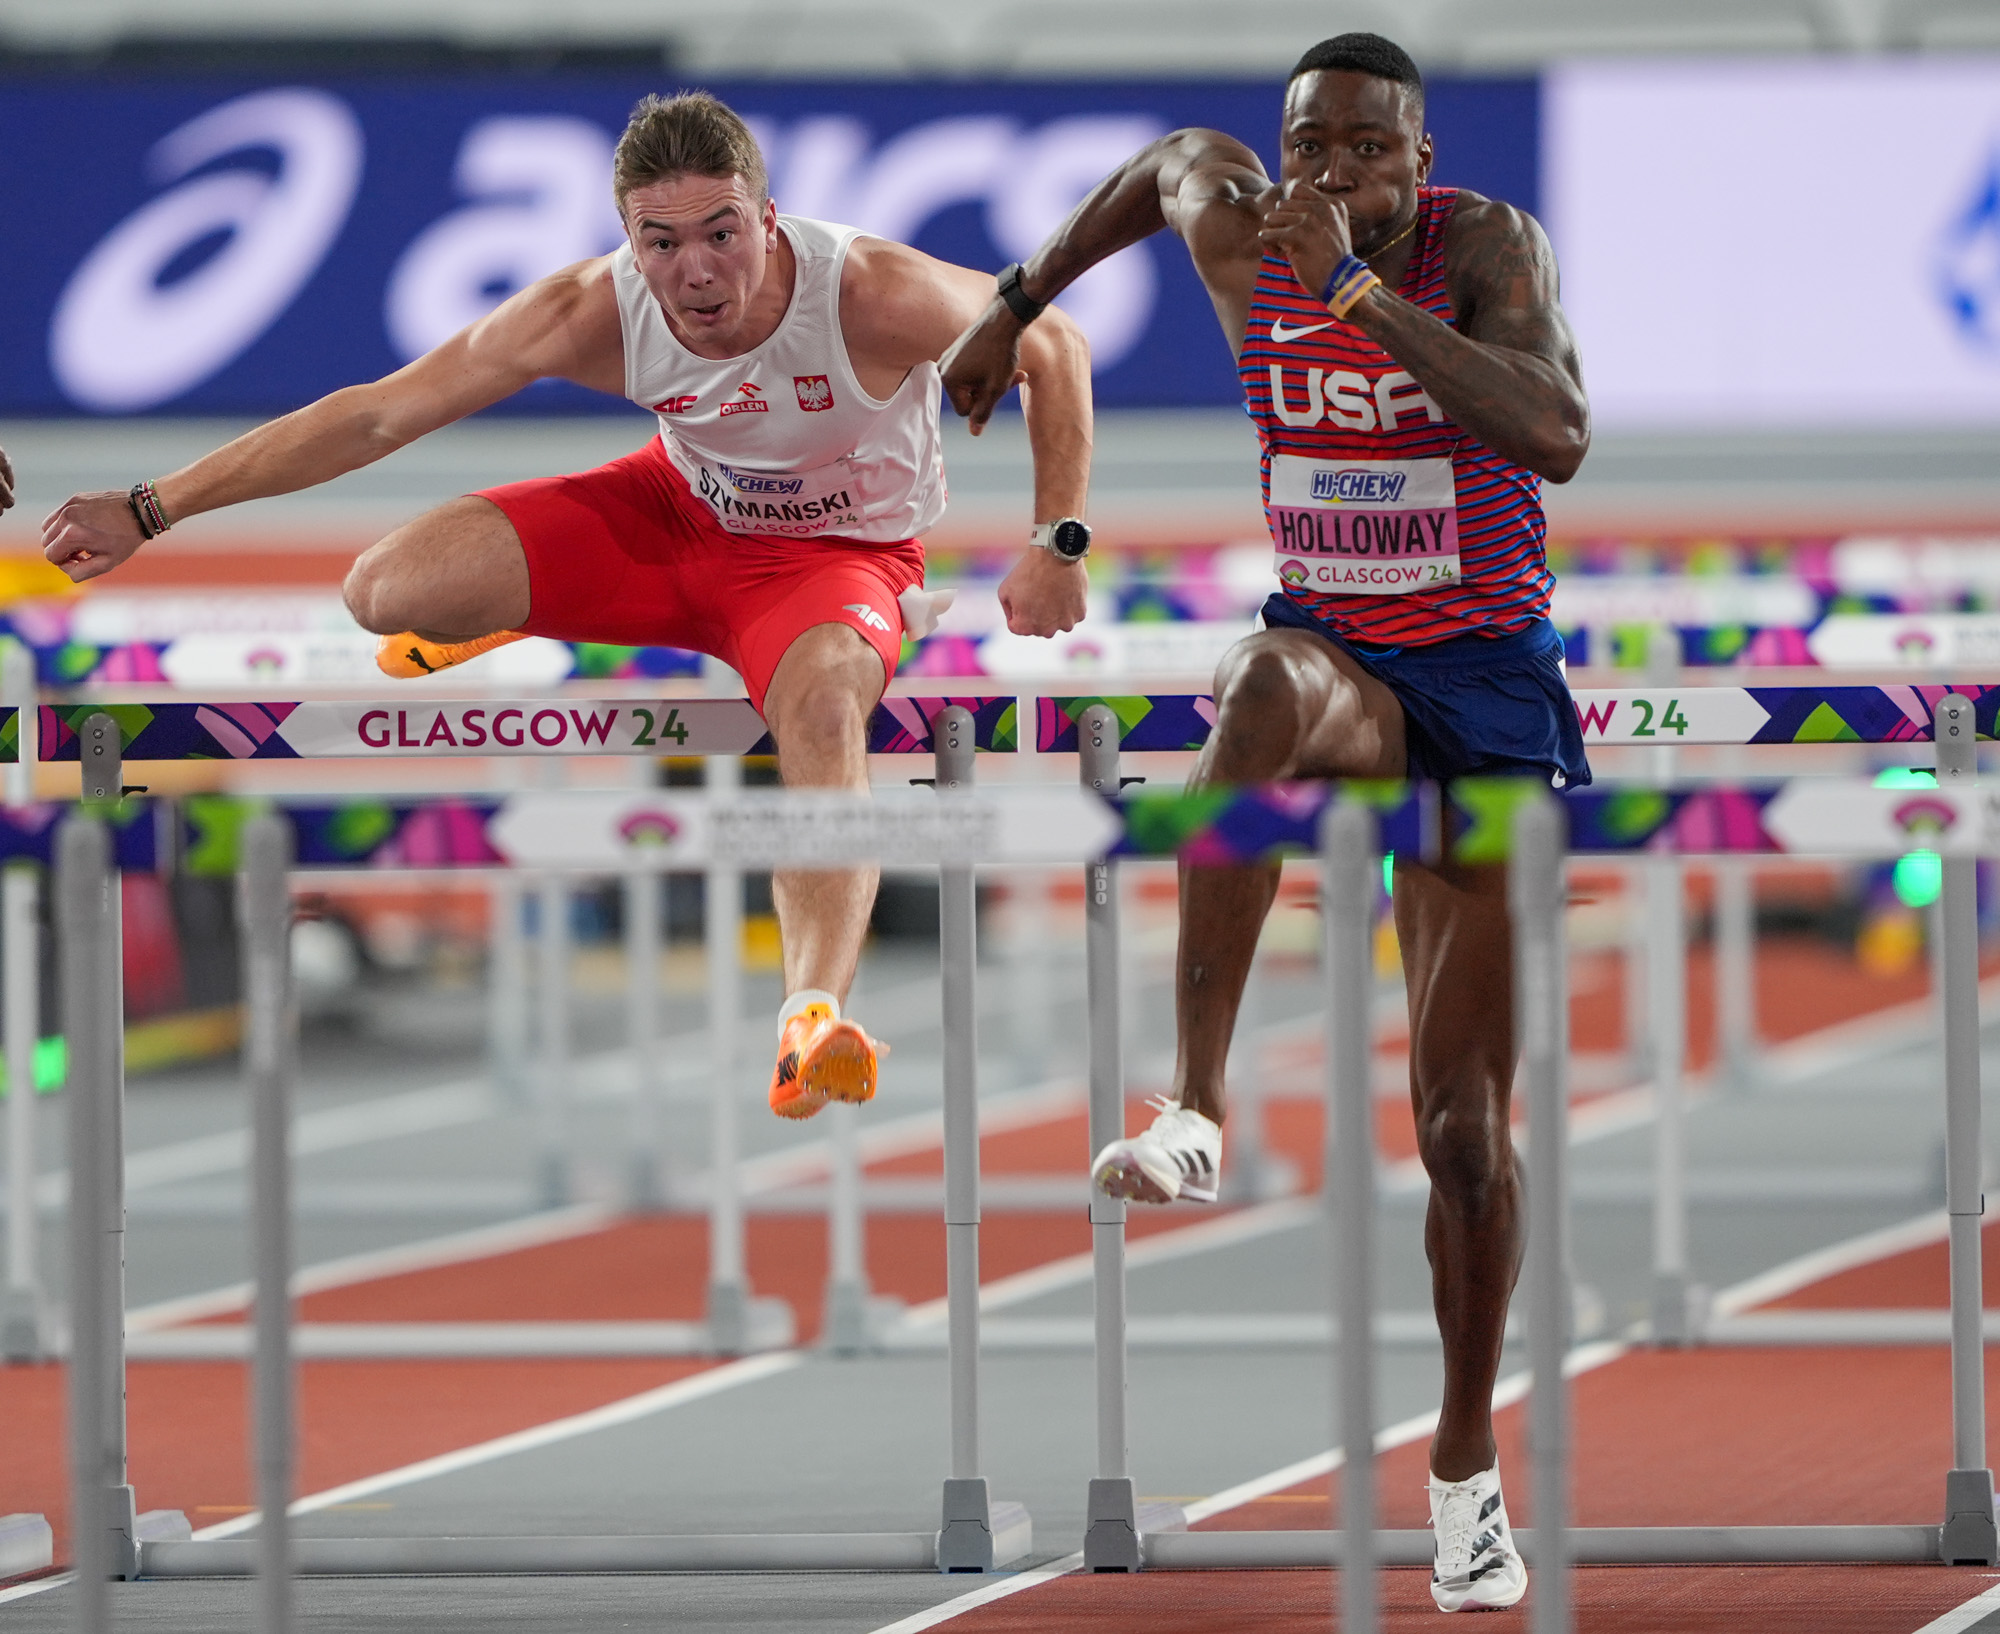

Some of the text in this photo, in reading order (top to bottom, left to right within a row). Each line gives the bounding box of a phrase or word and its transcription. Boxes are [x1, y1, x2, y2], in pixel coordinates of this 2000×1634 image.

[721, 402, 766, 415] ORLEN
[1269, 364, 1444, 432] USA
[699, 466, 852, 521] SZYMAŃSKI
[1311, 470, 1406, 502] HI-CHEW
[726, 512, 858, 534] GLASGOW 24
[1279, 511, 1446, 555] HOLLOWAY
[1316, 564, 1453, 584] GLASGOW 24
[357, 708, 689, 748] GLASGOW 24
[1630, 699, 1689, 736] 24
